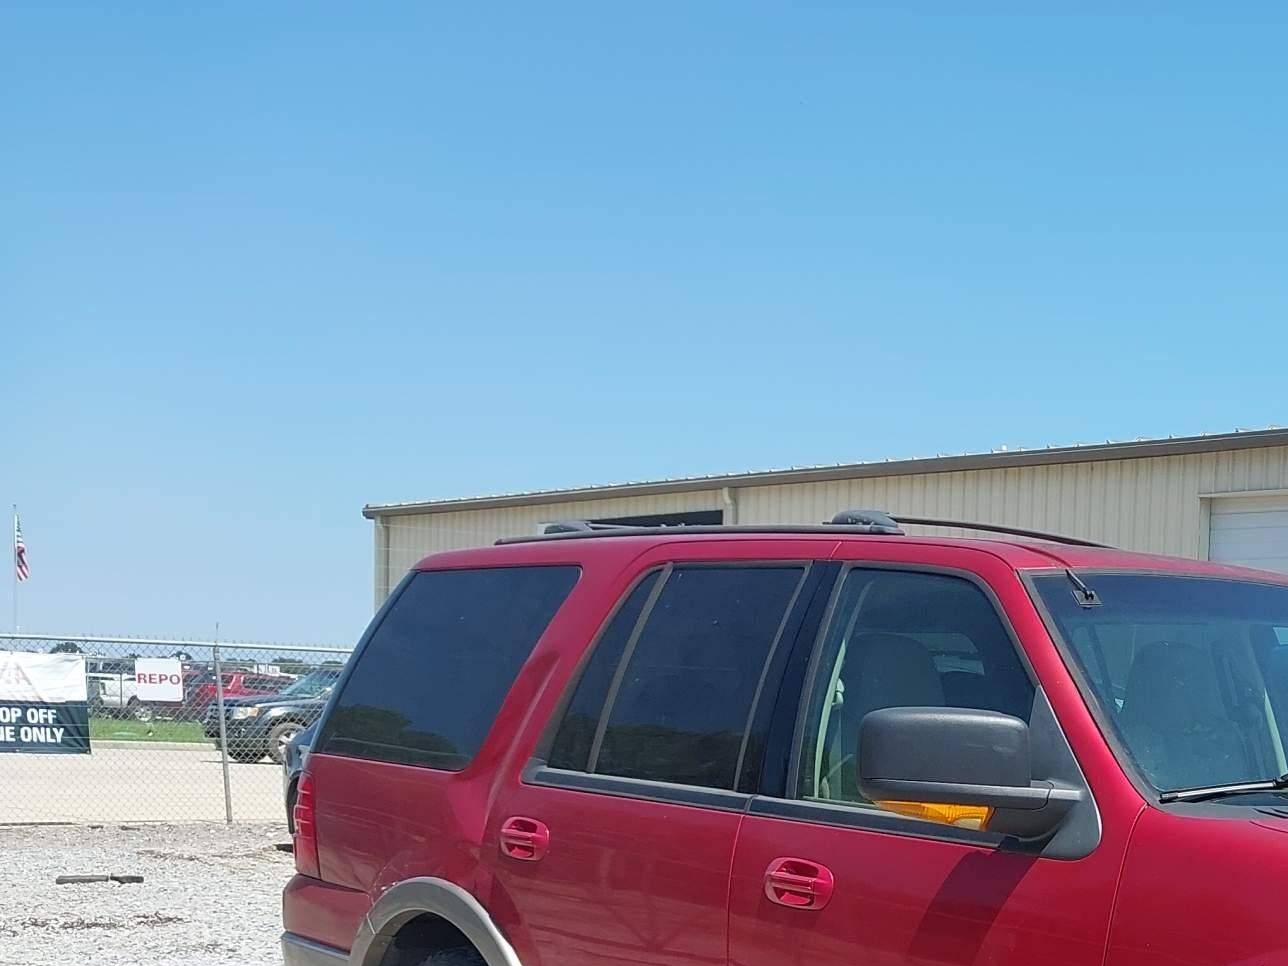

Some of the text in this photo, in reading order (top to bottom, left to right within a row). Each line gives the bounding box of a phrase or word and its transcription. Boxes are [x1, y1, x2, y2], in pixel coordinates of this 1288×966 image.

[137, 673, 181, 685] REPO
[26, 707, 57, 724] OFF
[20, 726, 65, 743] ONLY
